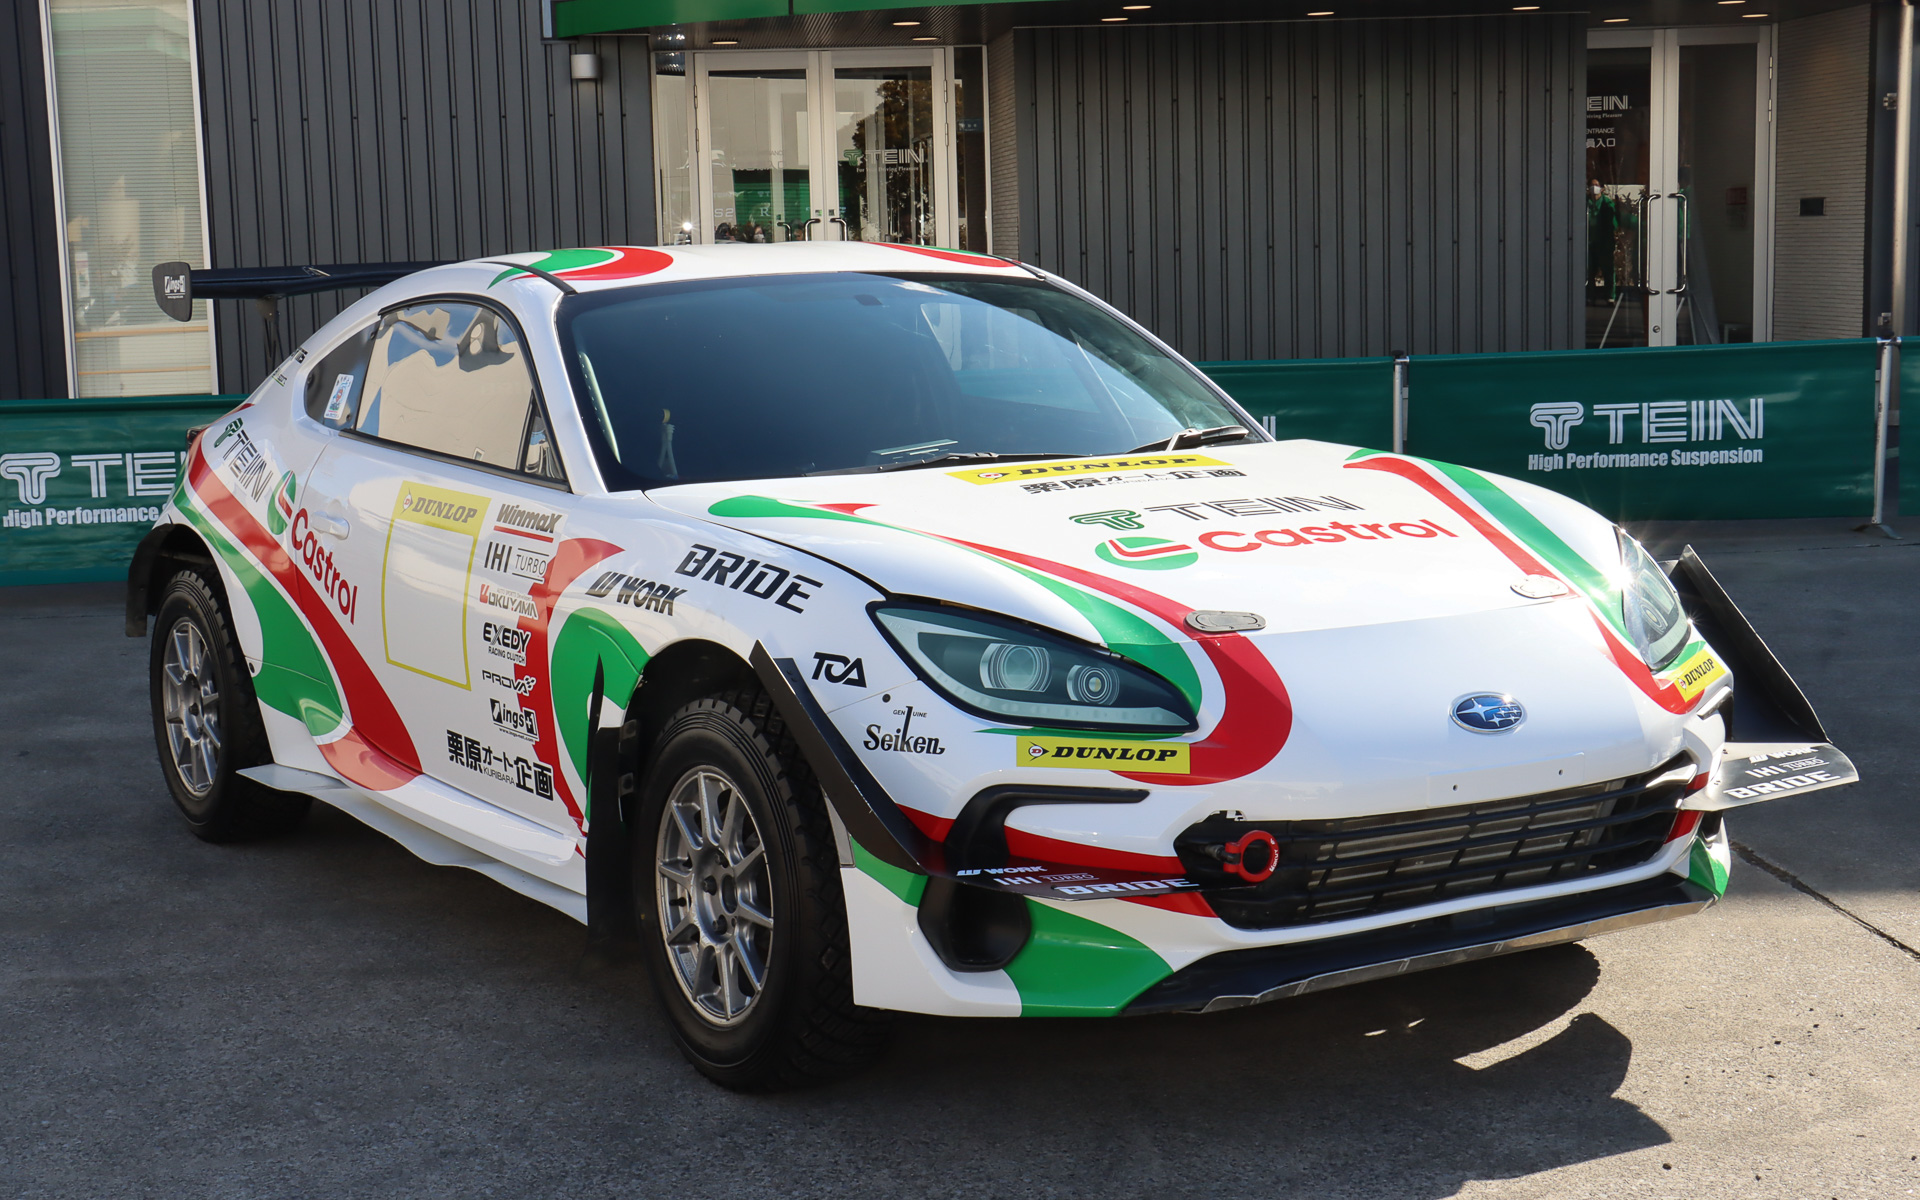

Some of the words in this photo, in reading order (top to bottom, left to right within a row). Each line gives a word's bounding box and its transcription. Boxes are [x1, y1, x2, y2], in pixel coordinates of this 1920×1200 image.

[865, 149, 924, 164] TEIN
[1593, 398, 1763, 444] TEIN
[222, 429, 274, 503] TEIN
[1018, 458, 1198, 476] DUNLOP
[1528, 453, 1563, 472] High
[1566, 452, 1668, 469] Performance
[1671, 447, 1763, 466] Suspension
[3, 508, 43, 529] High
[46, 506, 159, 526] Performance
[412, 497, 478, 523] DUNLOP
[1144, 495, 1366, 521] TEIN
[1198, 519, 1460, 552] Castrol
[292, 508, 358, 625] Castrol
[484, 542, 513, 573] IHI
[516, 554, 547, 576] TURBO
[674, 543, 824, 614] BRIDE
[488, 592, 538, 618] OKUYAMA
[616, 575, 688, 616] WORK
[483, 622, 530, 653] EXEDY
[488, 646, 506, 659] RACING
[507, 650, 526, 664] CLUTCH
[482, 669, 528, 694] PROVA
[1684, 658, 1715, 686] DUNLOP
[863, 706, 945, 755] Seiken
[446, 729, 554, 801] 栗原オート企画
[1051, 746, 1178, 762] DUNLOP
[1767, 746, 1819, 759] WORK
[483, 767, 515, 785] KURIBARA
[1722, 770, 1841, 799] BRIDE
[1744, 765, 1787, 778] IHI
[984, 865, 1048, 875] WORK
[993, 876, 1042, 886] IHI
[1043, 873, 1095, 882] TURBO
[1053, 878, 1200, 896] BRIDE
